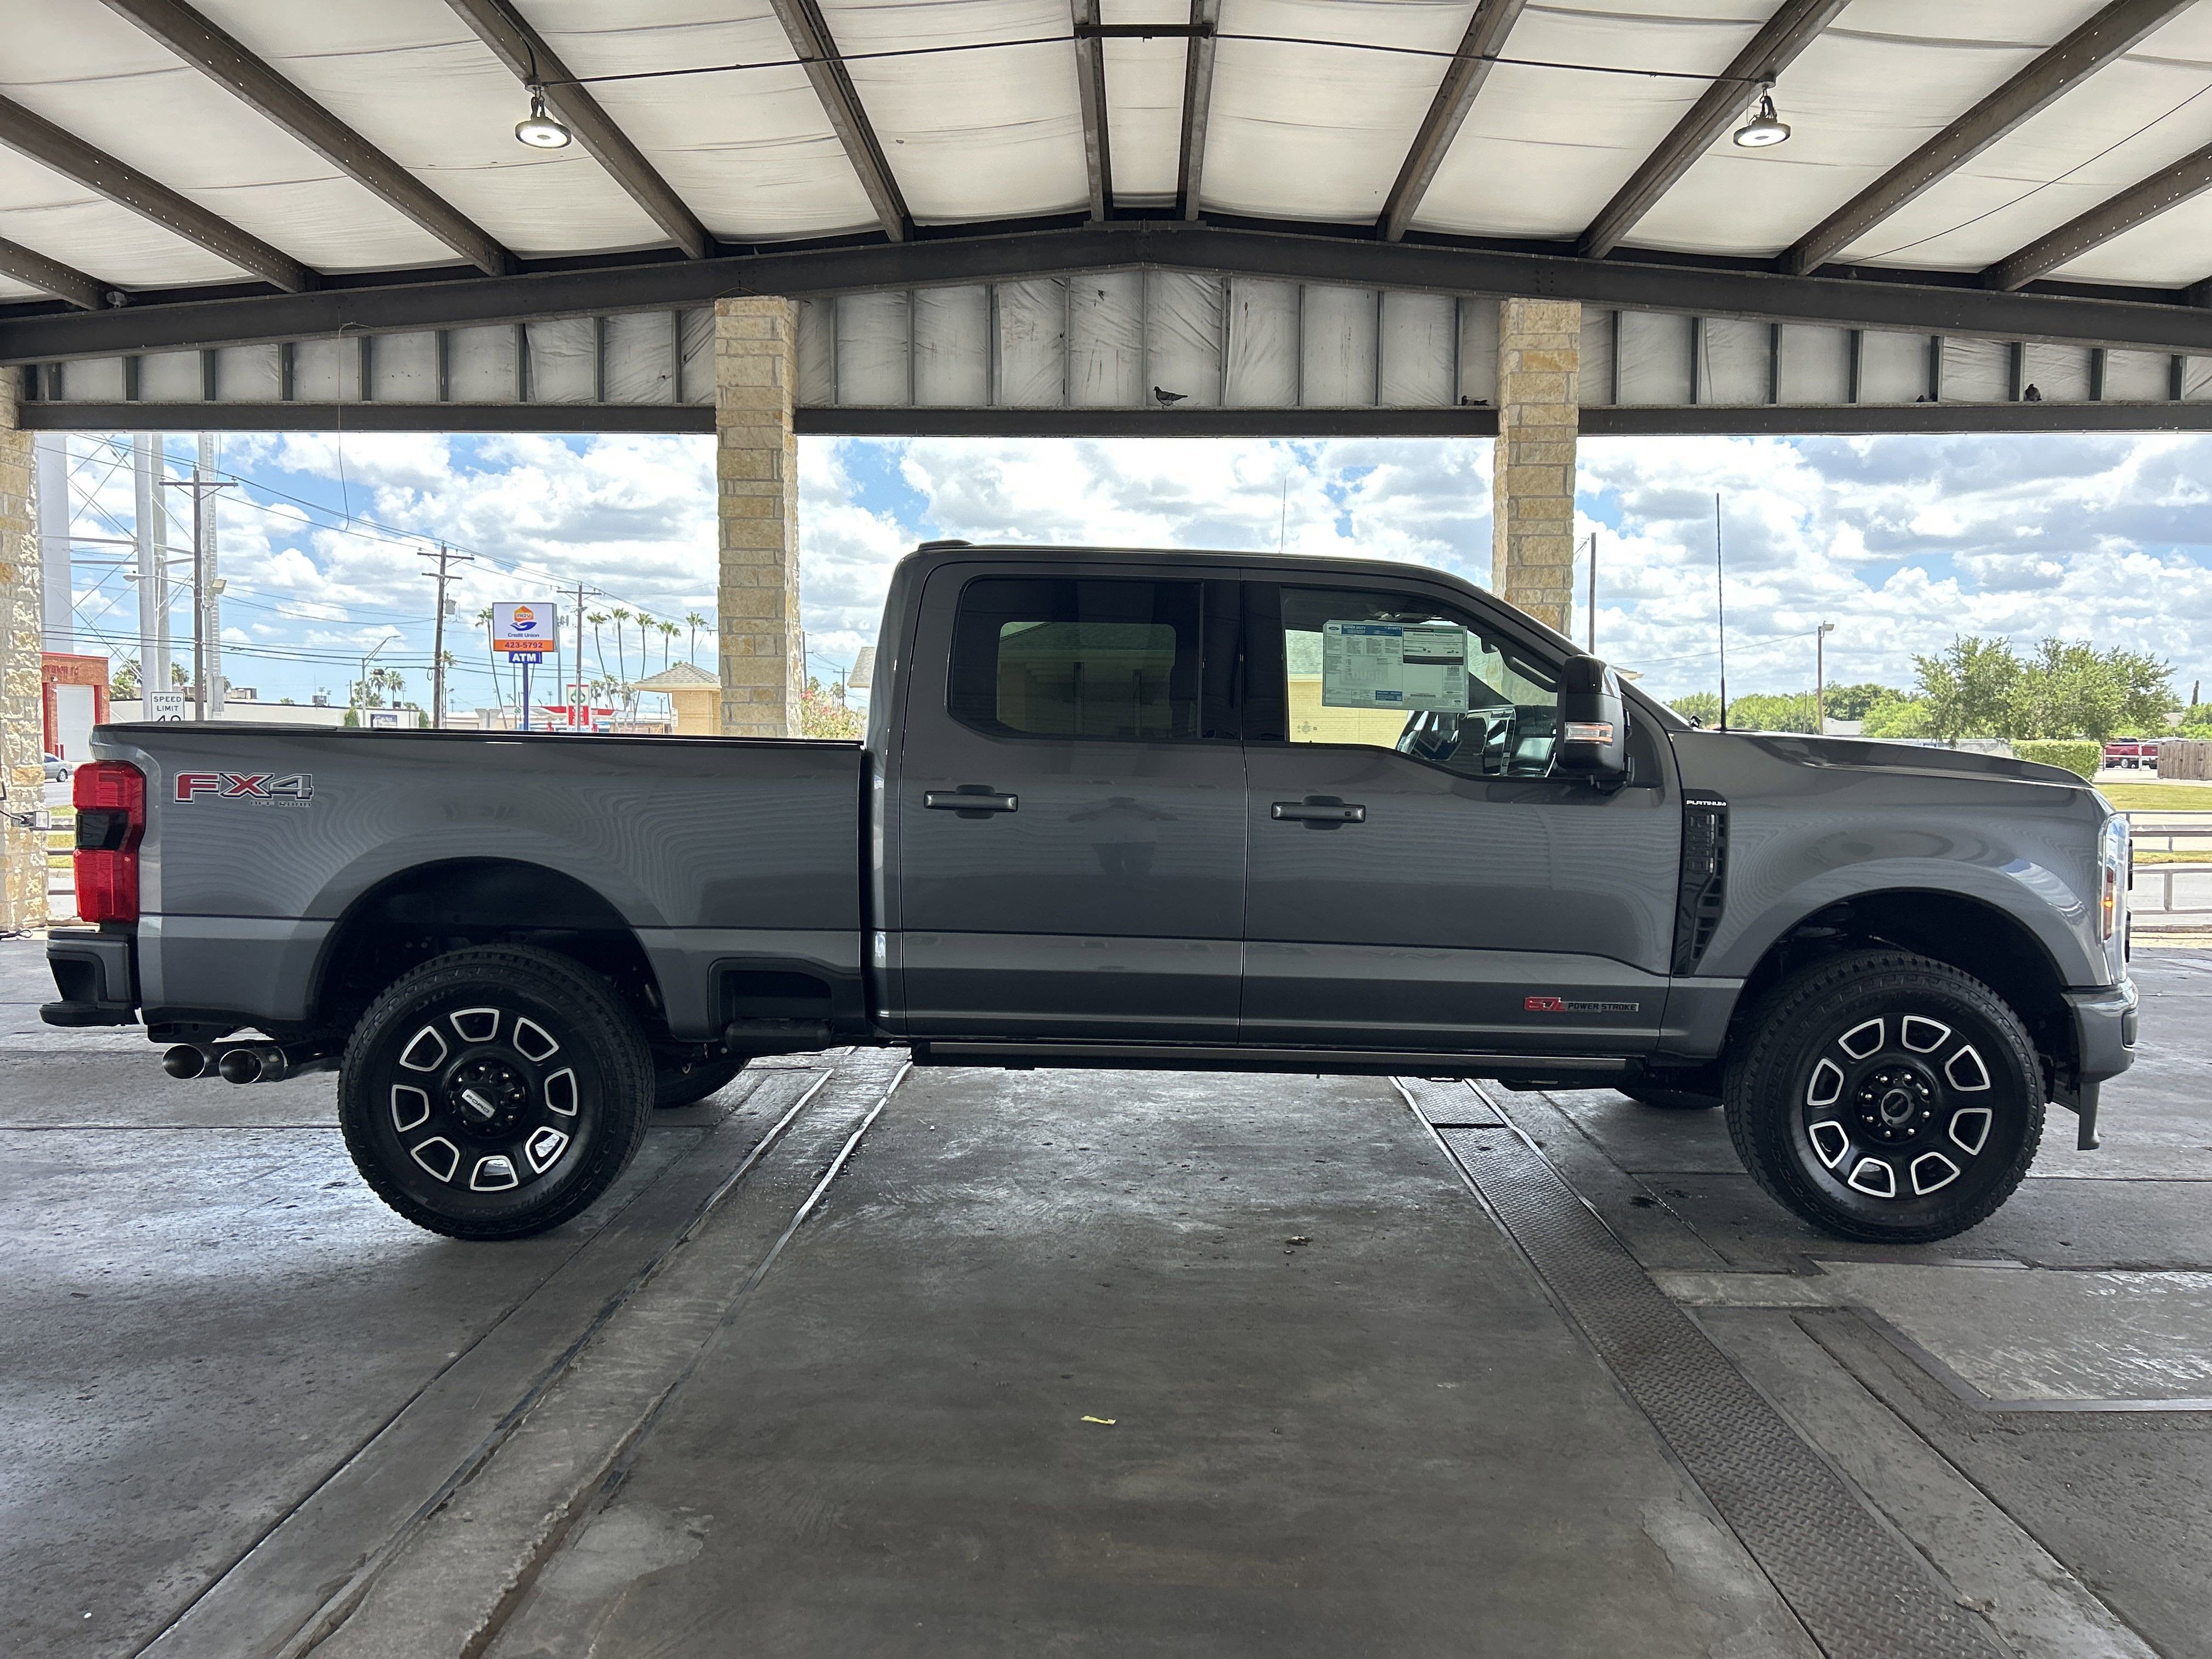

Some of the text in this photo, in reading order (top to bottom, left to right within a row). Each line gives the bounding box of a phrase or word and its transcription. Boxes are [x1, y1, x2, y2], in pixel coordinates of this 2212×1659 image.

[512, 653, 536, 662] ATM
[174, 770, 314, 804] FX4
[466, 1094, 490, 1113] FORD
